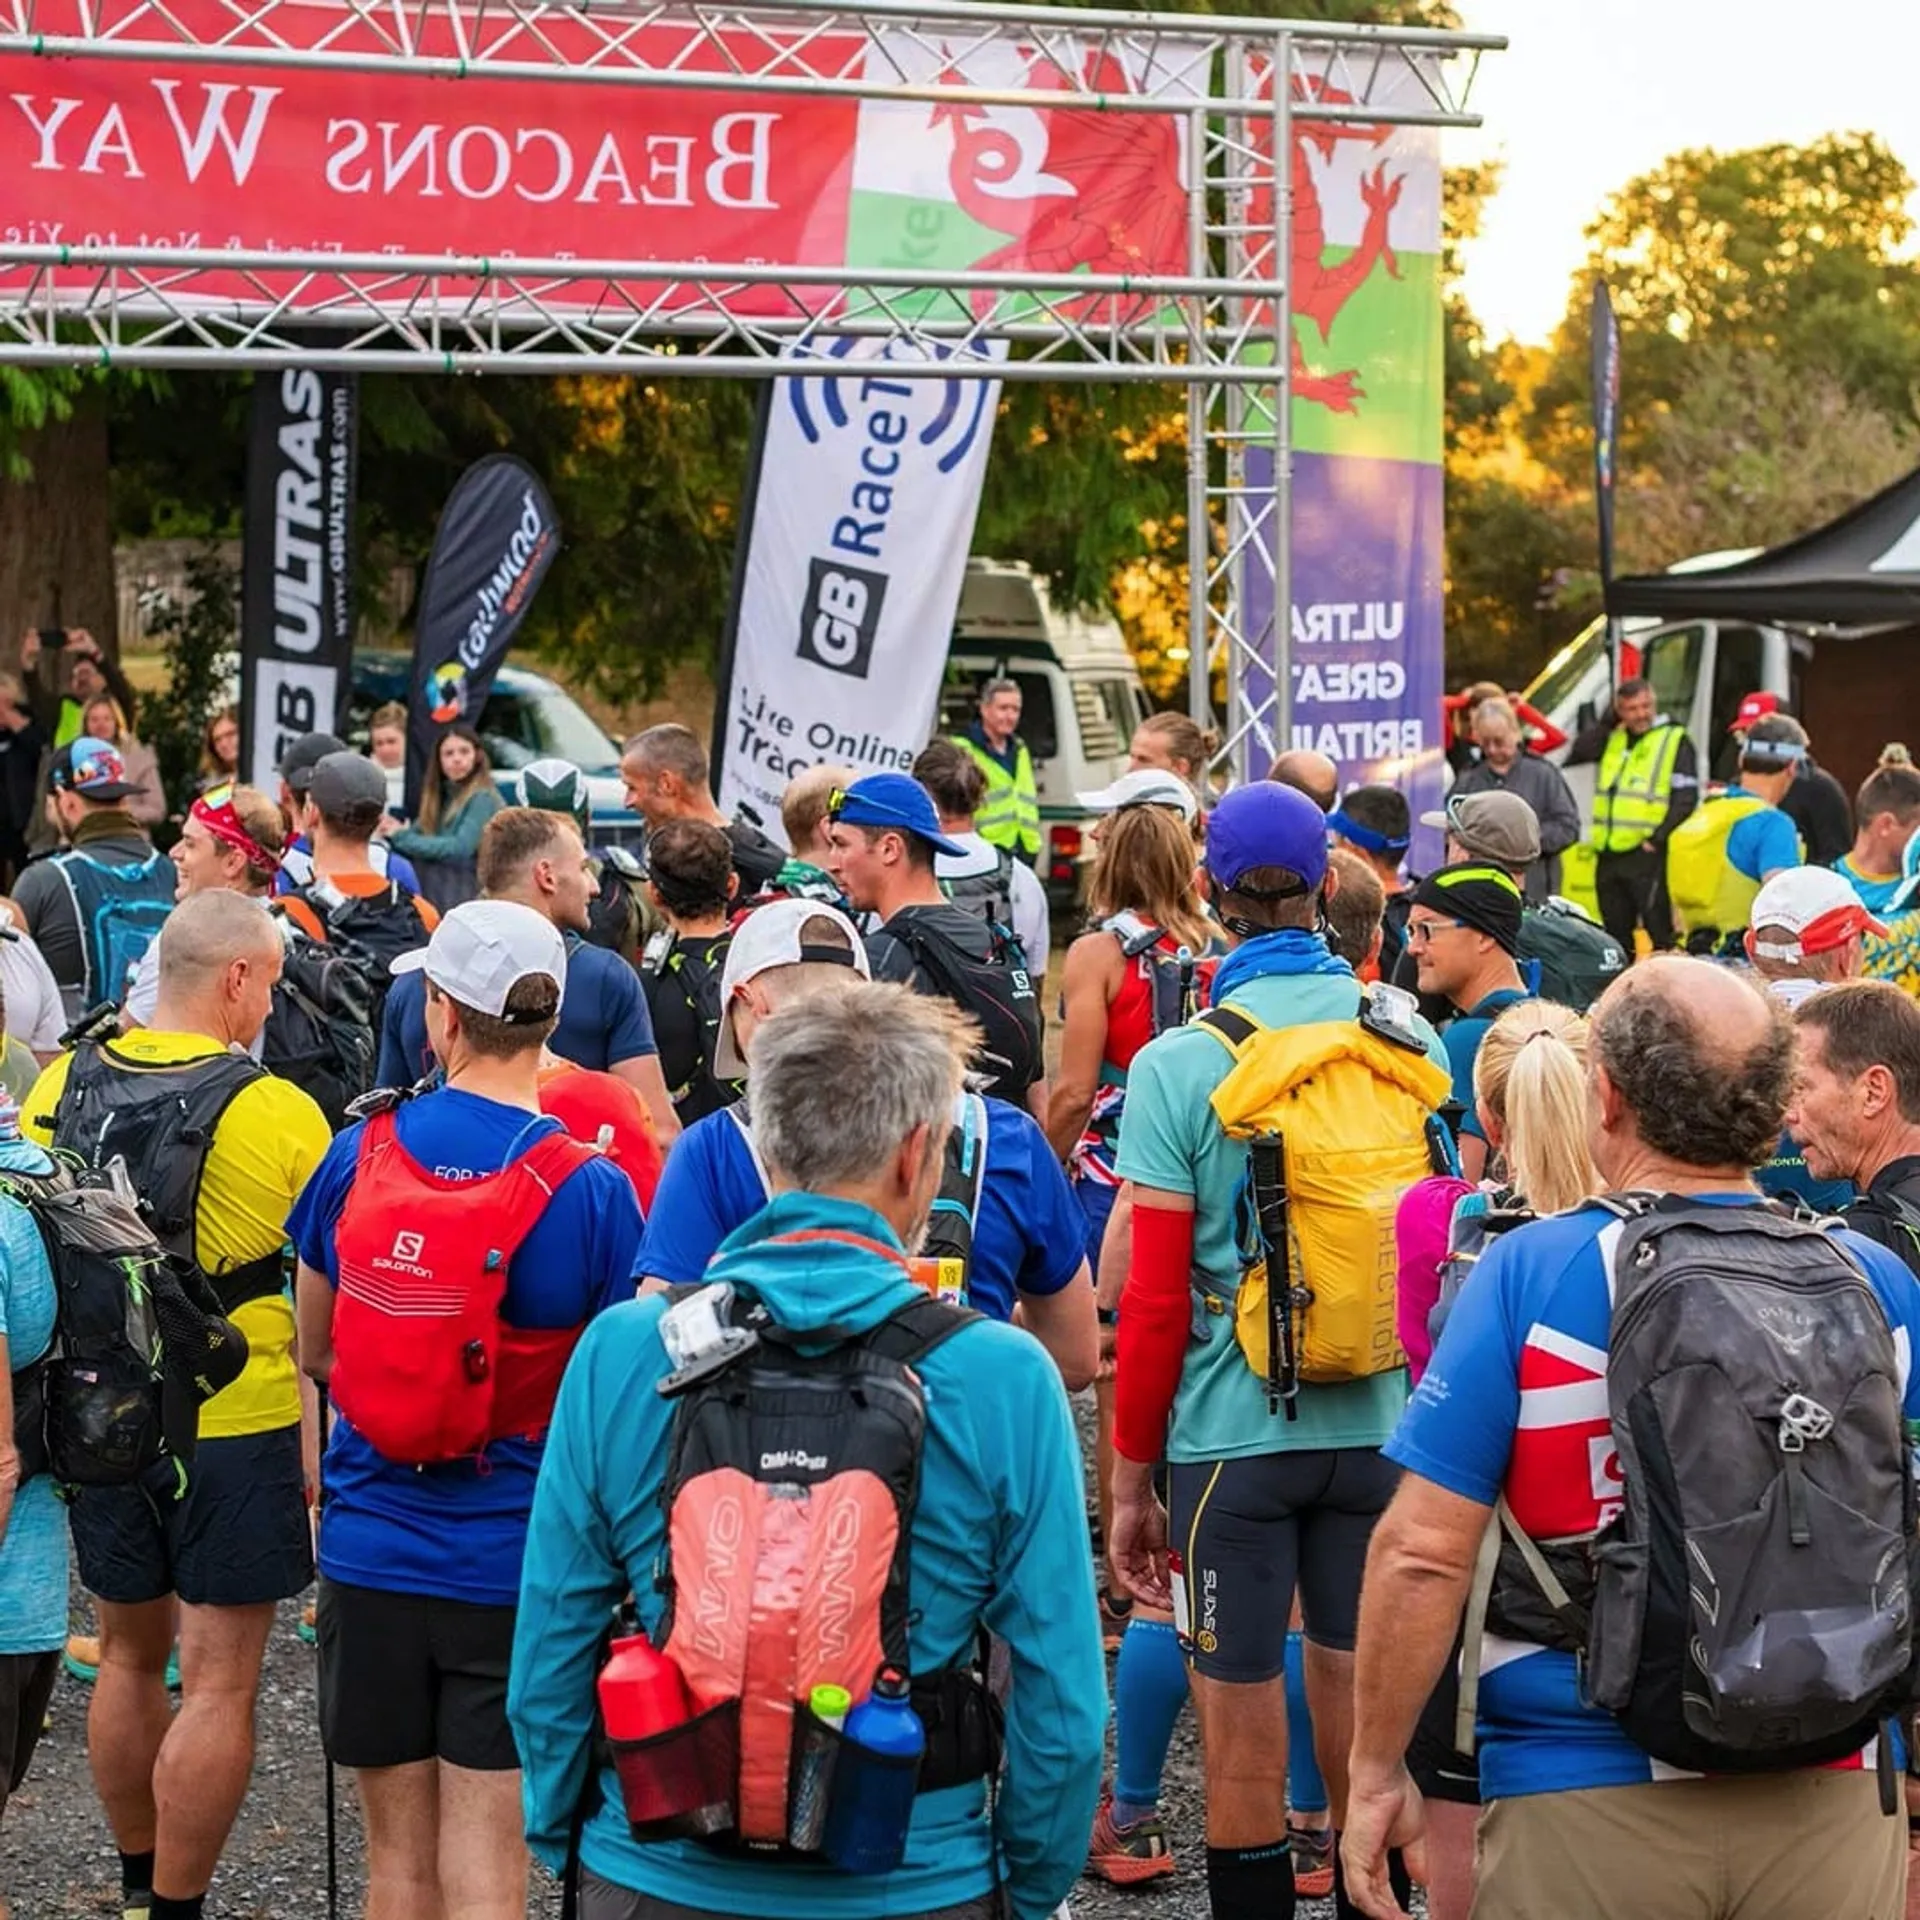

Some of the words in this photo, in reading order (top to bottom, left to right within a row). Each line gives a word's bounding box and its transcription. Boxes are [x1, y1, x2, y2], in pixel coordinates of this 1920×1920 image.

[274, 367, 323, 653] ULTRAS
[811, 570, 870, 668] GB
[807, 719, 914, 772] Online
